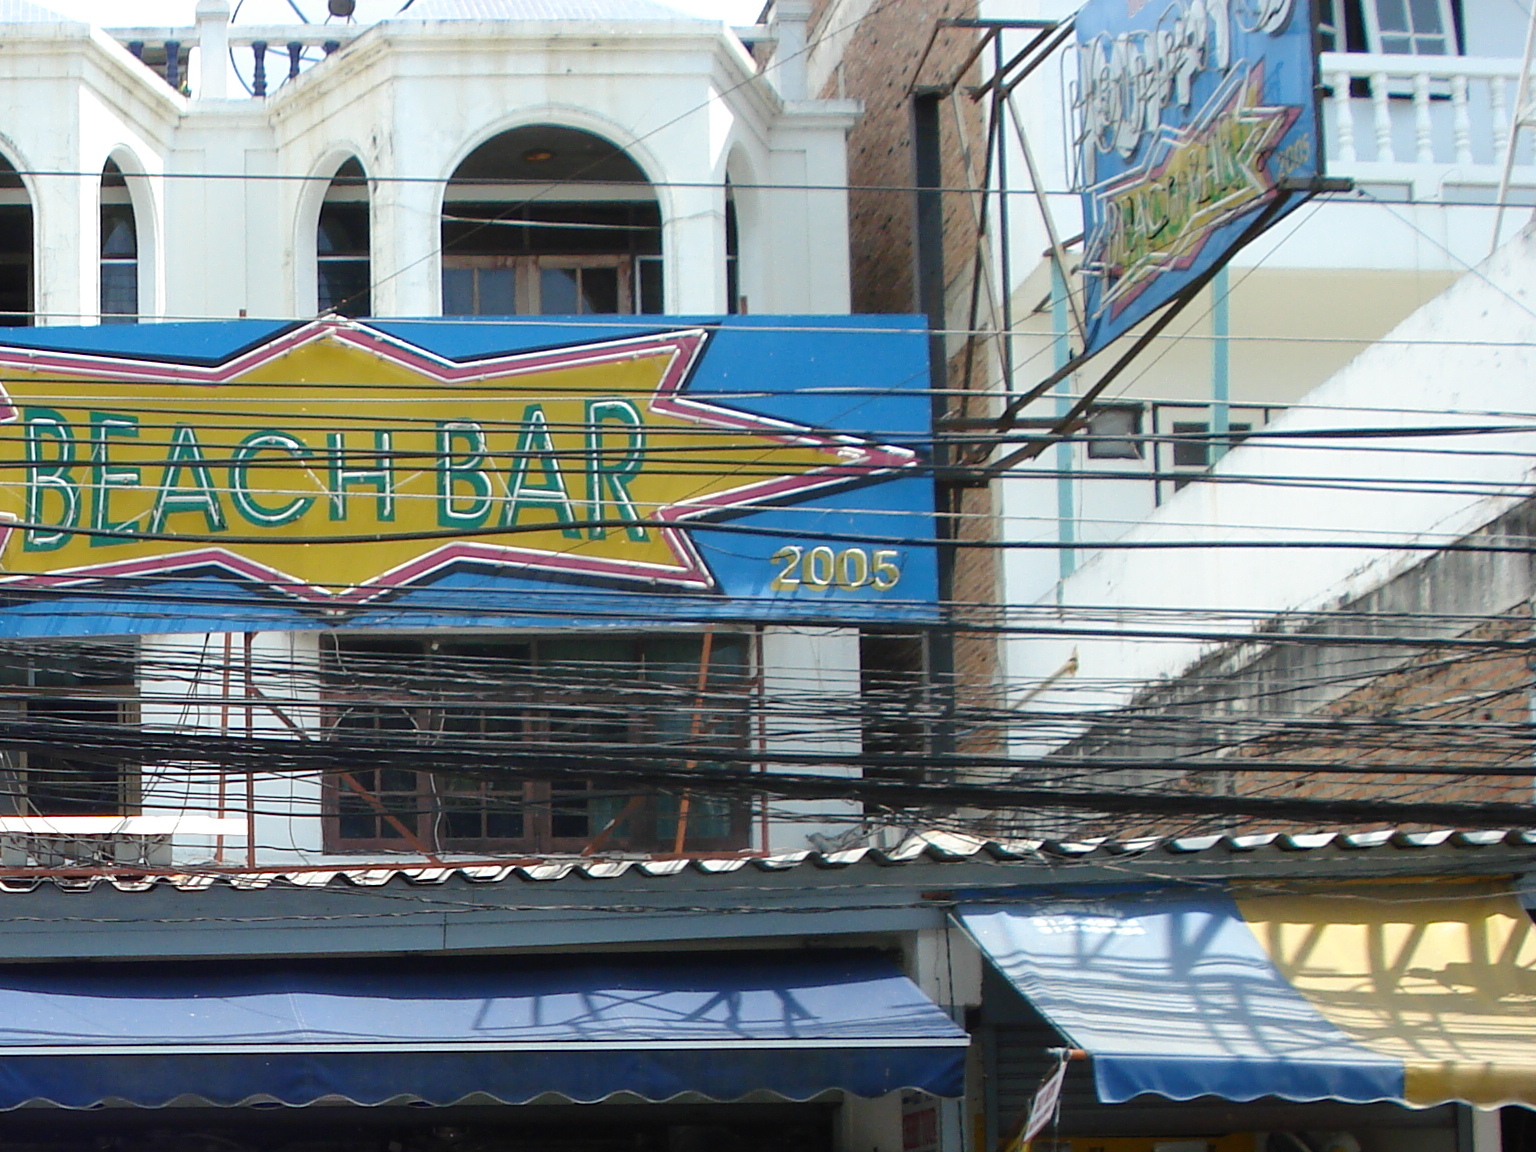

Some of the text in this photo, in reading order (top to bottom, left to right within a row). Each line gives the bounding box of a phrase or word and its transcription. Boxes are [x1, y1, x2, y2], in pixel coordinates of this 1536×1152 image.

[22, 399, 652, 552] BEACH BAR
[770, 545, 901, 593] 2005
